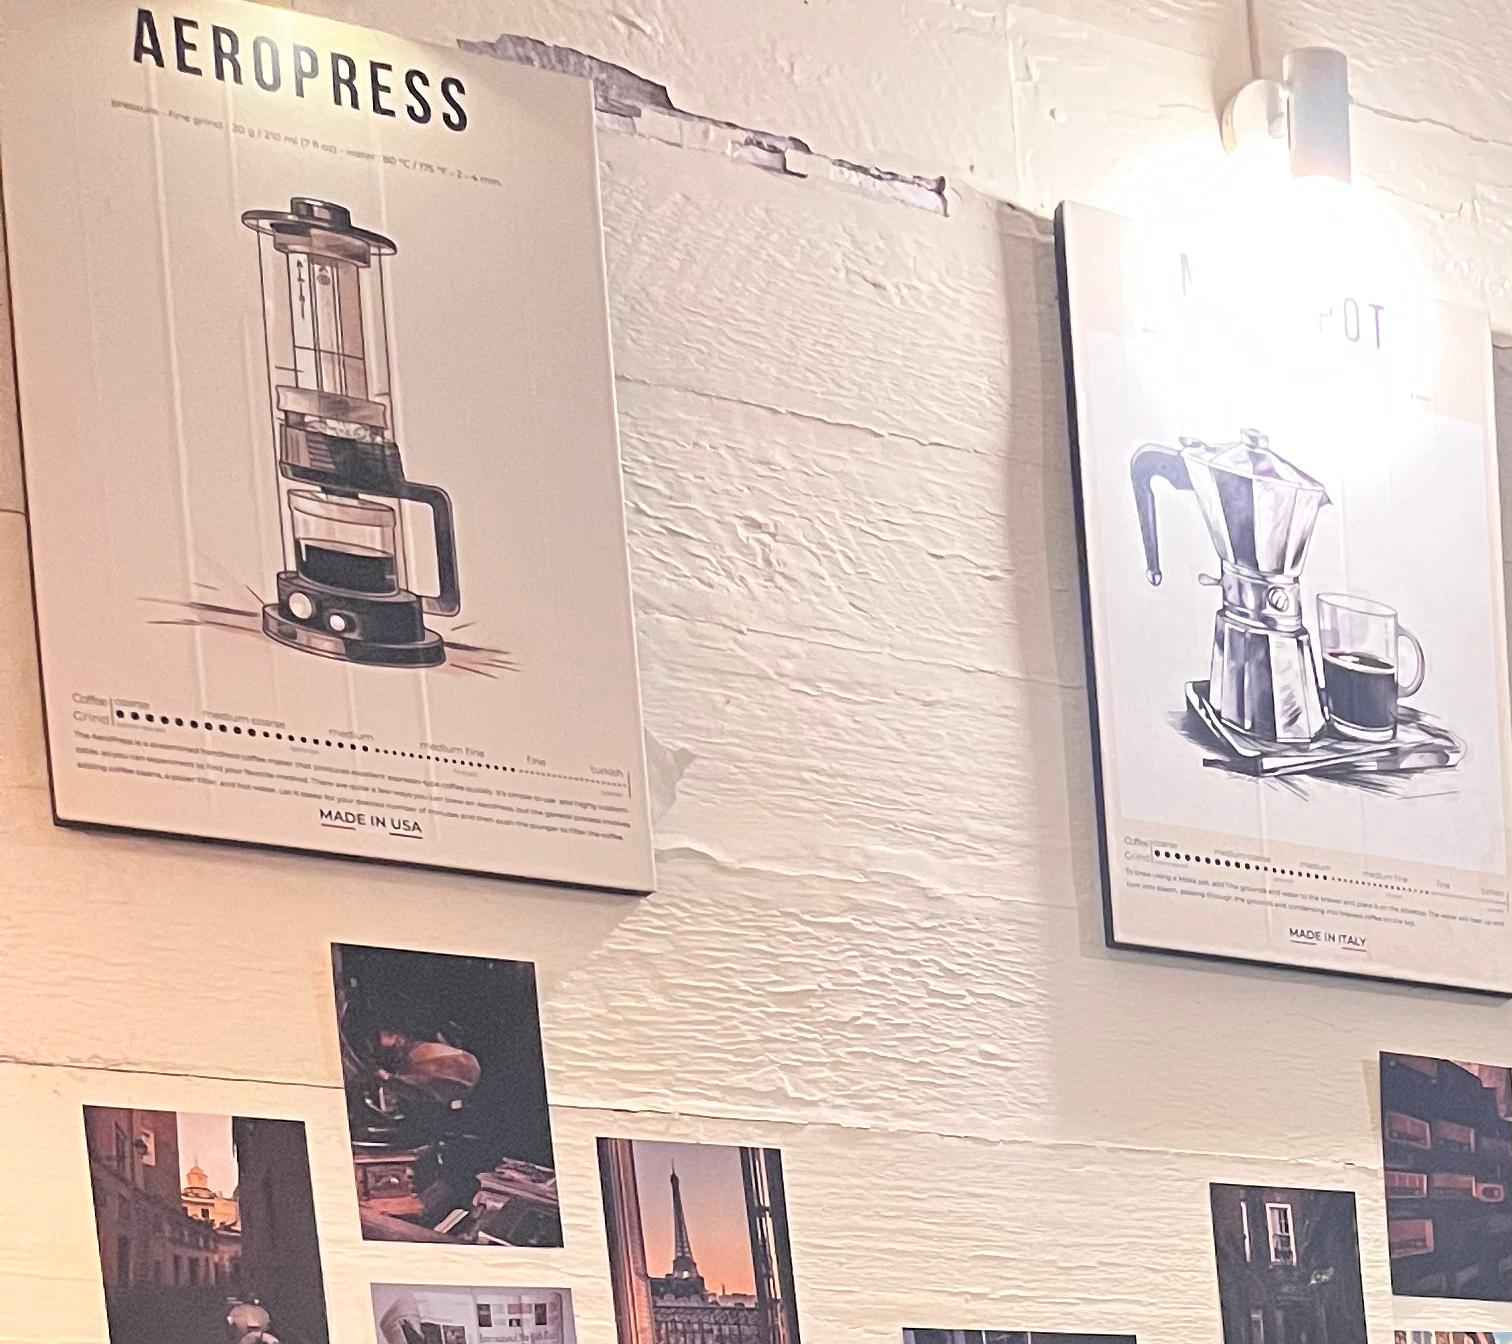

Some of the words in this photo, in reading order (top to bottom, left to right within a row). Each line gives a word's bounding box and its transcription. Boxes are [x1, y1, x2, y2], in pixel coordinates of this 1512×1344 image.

[133, 7, 469, 133] AEROPRESS
[319, 808, 366, 827] MADE
[370, 814, 387, 829] IN
[391, 818, 423, 834] USA
[1289, 927, 1321, 941] MADE
[1324, 931, 1336, 943] IN
[1338, 934, 1366, 946] ITALY
